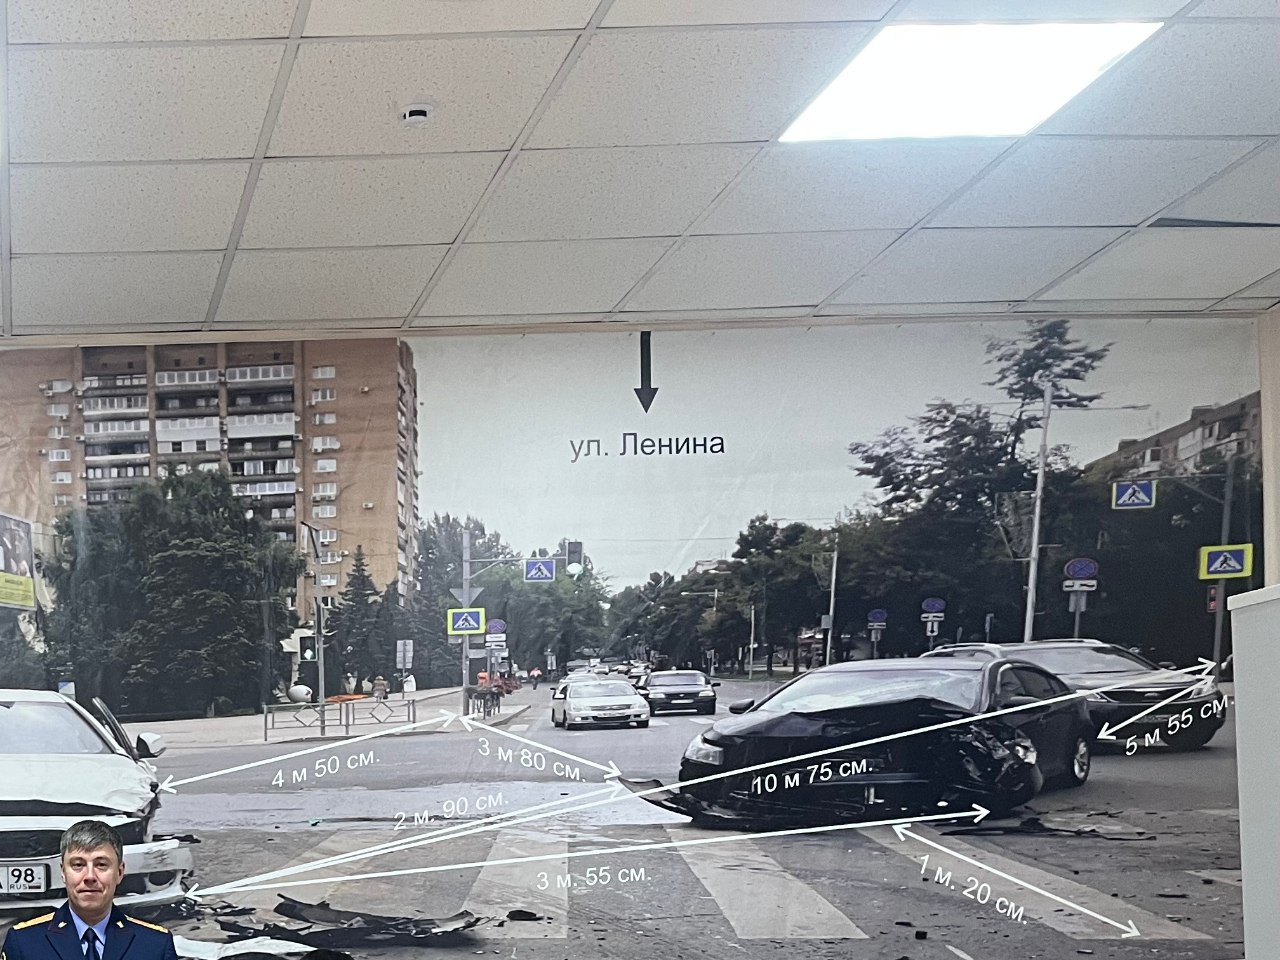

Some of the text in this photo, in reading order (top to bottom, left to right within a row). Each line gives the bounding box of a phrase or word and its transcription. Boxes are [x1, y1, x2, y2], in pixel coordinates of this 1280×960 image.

[570, 433, 725, 463] ул. Ленина
[1125, 735, 1137, 756] 5
[1167, 708, 1193, 735] 55
[1200, 695, 1234, 719] см.
[271, 769, 284, 788] 4
[314, 755, 340, 778] 50
[347, 750, 380, 769] см.
[478, 738, 490, 756] 3
[520, 749, 546, 771] 80
[553, 762, 586, 782] см.
[753, 773, 777, 794] 10
[806, 762, 833, 784] 75
[839, 759, 873, 777] см.
[393, 812, 407, 831] 2
[443, 797, 468, 818] 90
[476, 792, 509, 811] см.
[11, 868, 35, 884] 98
[536, 872, 549, 890] 3
[585, 866, 611, 886] 55
[618, 868, 652, 883] см.
[920, 854, 929, 875] 1
[962, 876, 991, 905] 20
[995, 897, 1028, 925] см.
